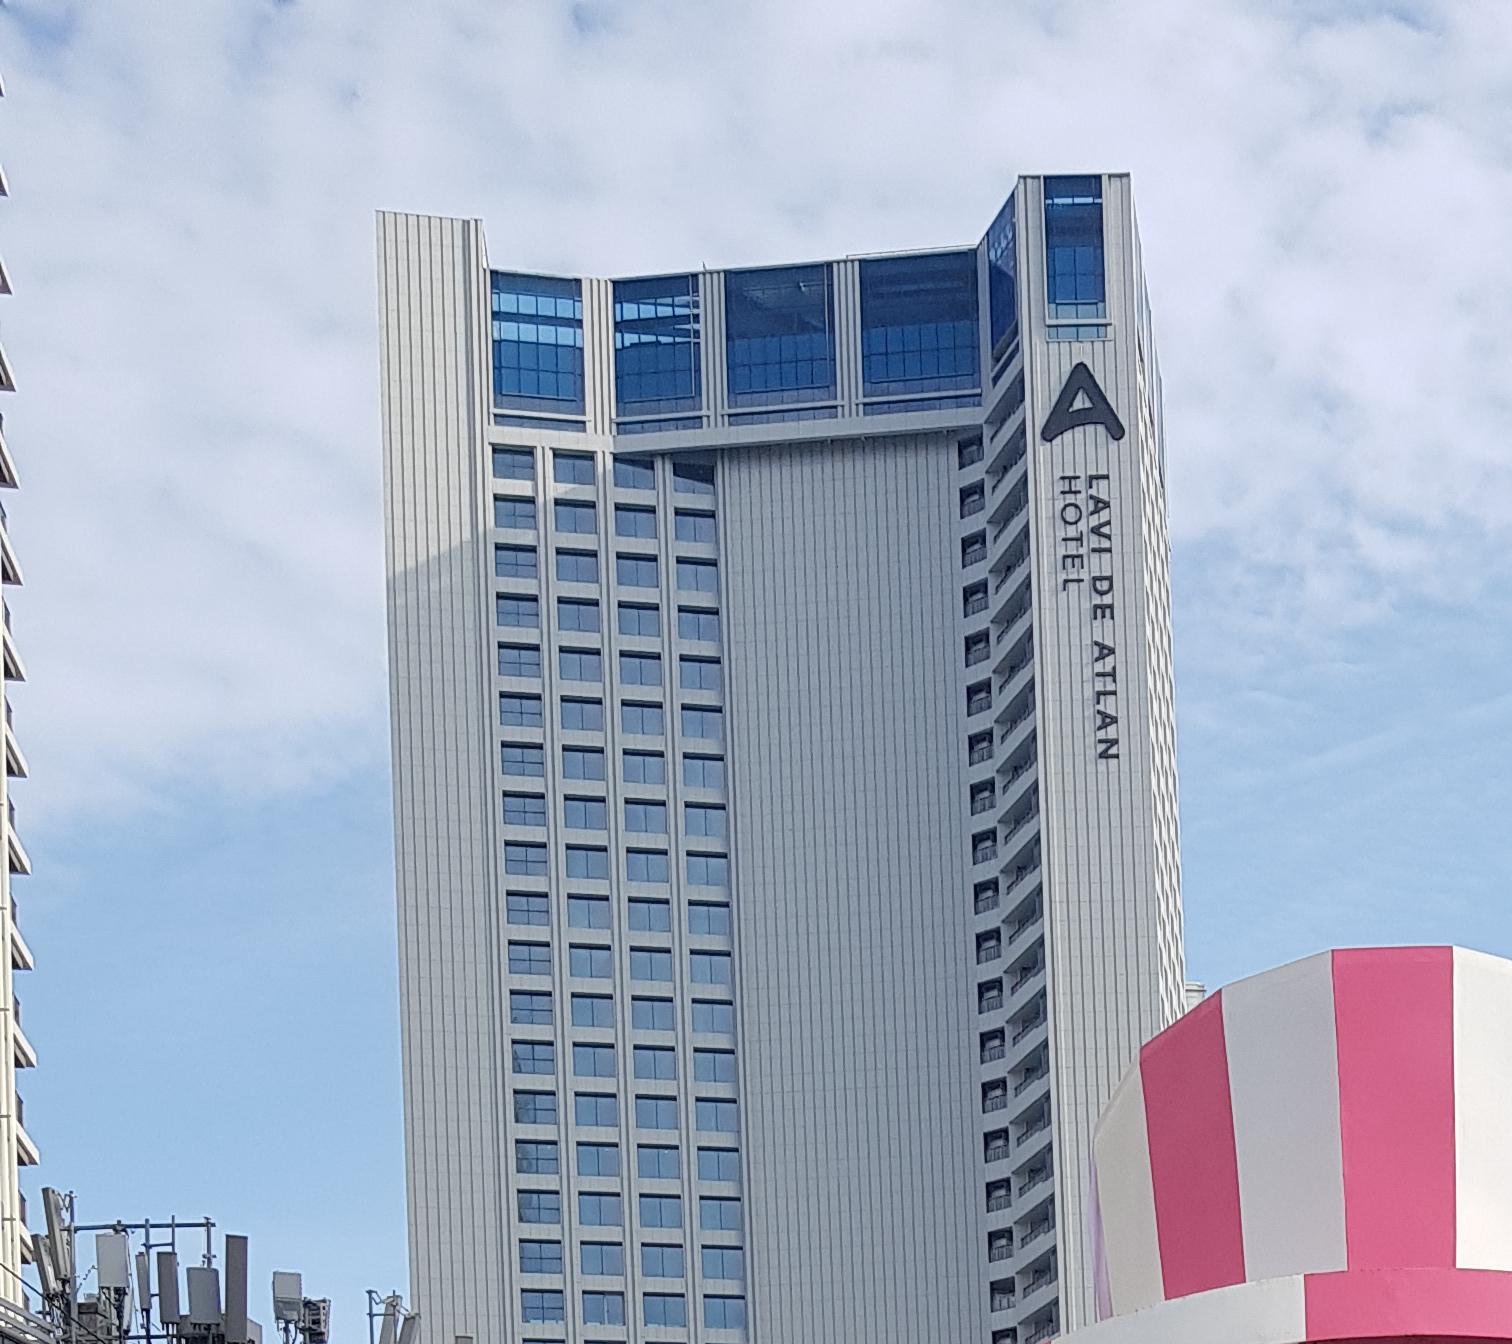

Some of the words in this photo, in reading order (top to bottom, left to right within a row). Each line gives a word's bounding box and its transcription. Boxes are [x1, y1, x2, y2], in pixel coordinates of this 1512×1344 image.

[1059, 475, 1085, 592] HOTEL
[1088, 474, 1113, 553] LAVI
[1091, 575, 1115, 620] DE
[1093, 640, 1120, 760] ATLAN
